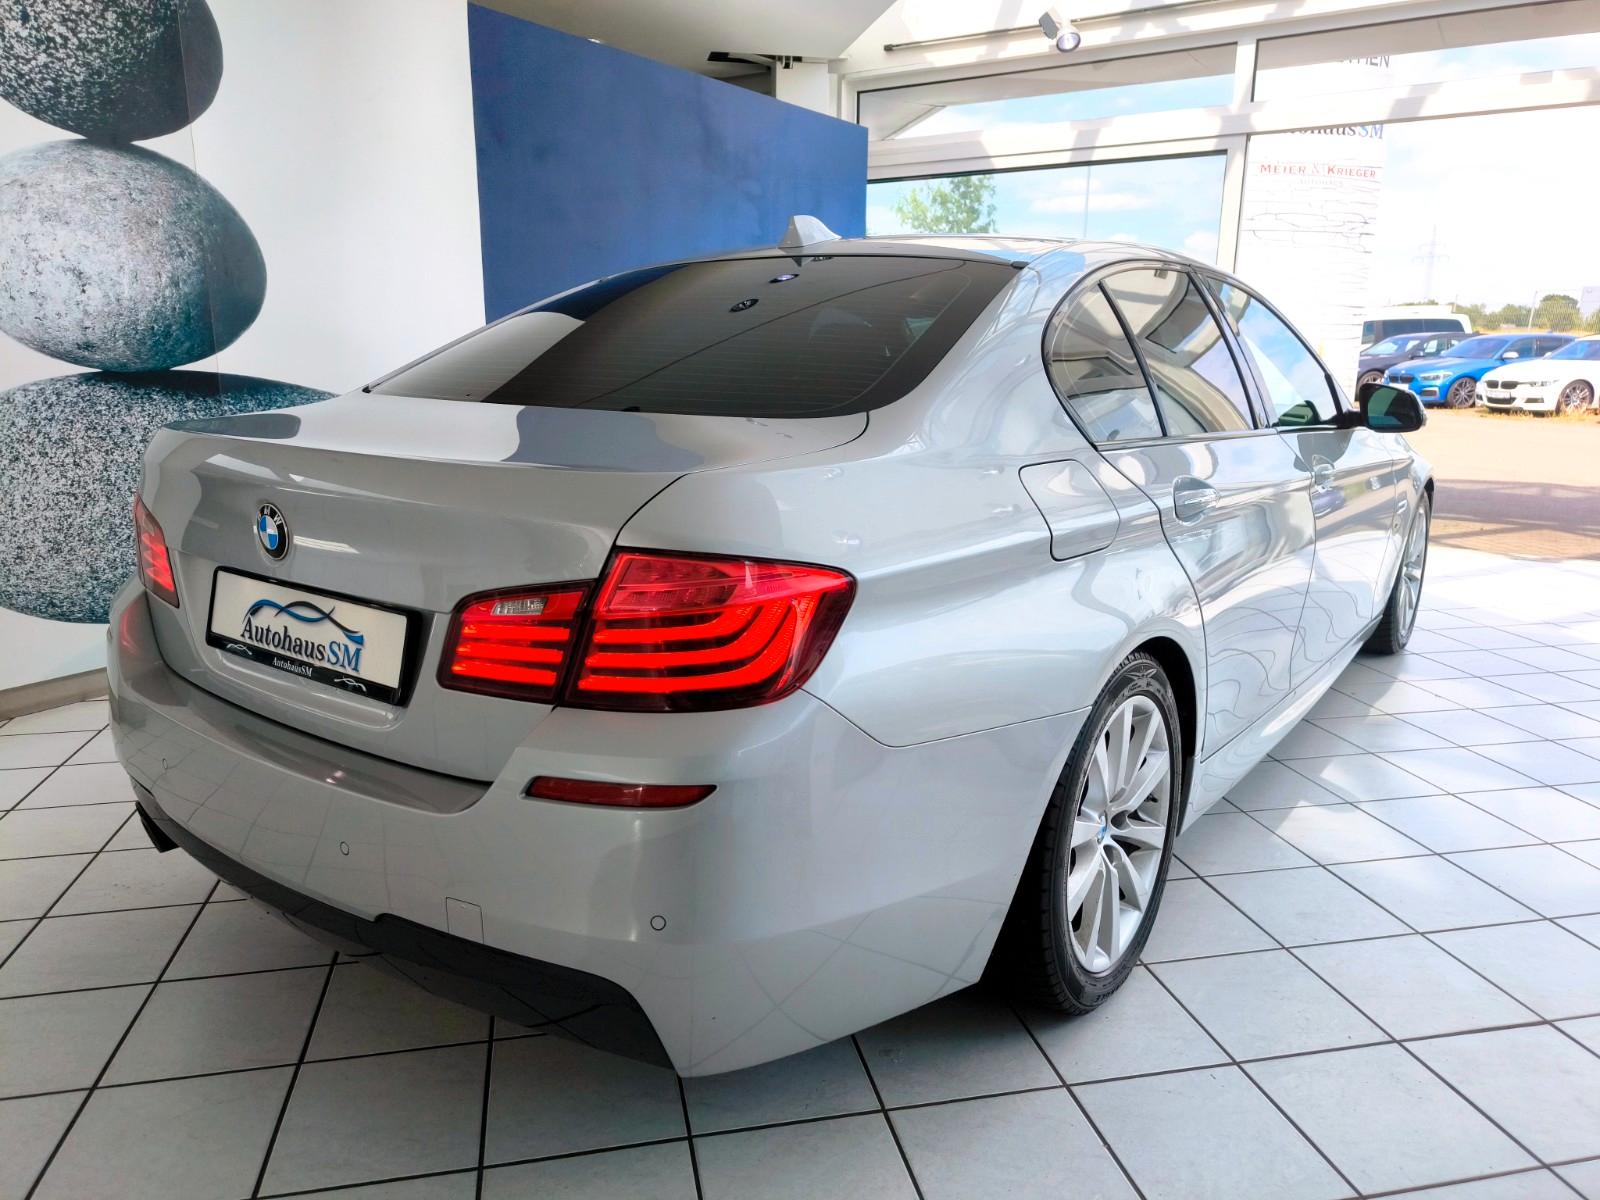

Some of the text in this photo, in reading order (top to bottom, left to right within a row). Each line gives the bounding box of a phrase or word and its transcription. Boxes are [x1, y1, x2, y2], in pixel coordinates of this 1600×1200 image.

[1260, 164, 1307, 175] MEIER
[1327, 164, 1376, 178] KRIEGER
[240, 614, 364, 673] AutohausSM
[272, 656, 313, 677] AutohausSM
